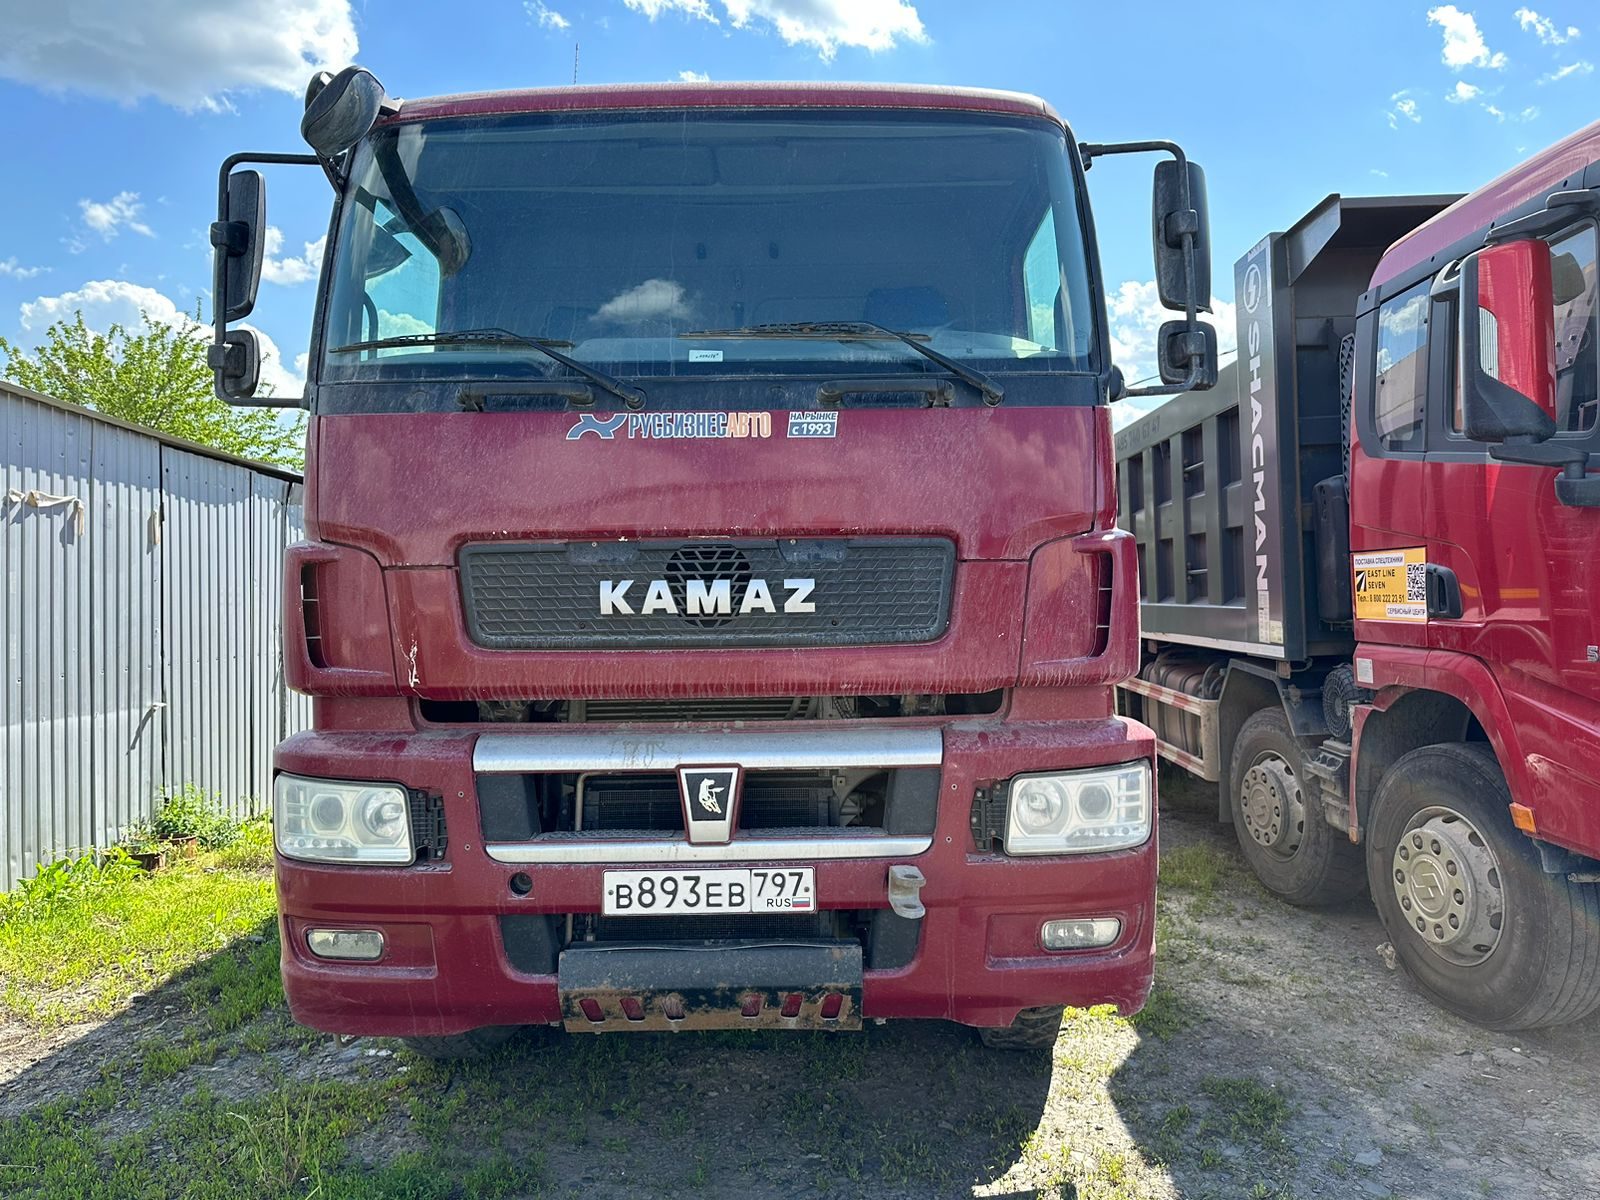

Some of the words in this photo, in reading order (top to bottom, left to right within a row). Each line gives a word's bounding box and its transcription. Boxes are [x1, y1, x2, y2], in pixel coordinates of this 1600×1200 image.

[790, 412, 802, 420] НА
[804, 412, 837, 420] РЫНКЕ
[628, 412, 771, 438] РУСБИЗНЕСАВТО
[801, 423, 831, 435] 1993
[1249, 320, 1268, 590] SHACMAN
[1367, 569, 1381, 578] EAST
[1382, 569, 1396, 577] LINE
[1367, 581, 1386, 589] SEVEN
[600, 579, 815, 614] KAMAZ
[1382, 594, 1392, 603] 222
[1392, 594, 1398, 603] 23
[1398, 594, 1405, 603] 51
[753, 872, 804, 897] 797
[766, 898, 791, 907] RUS
